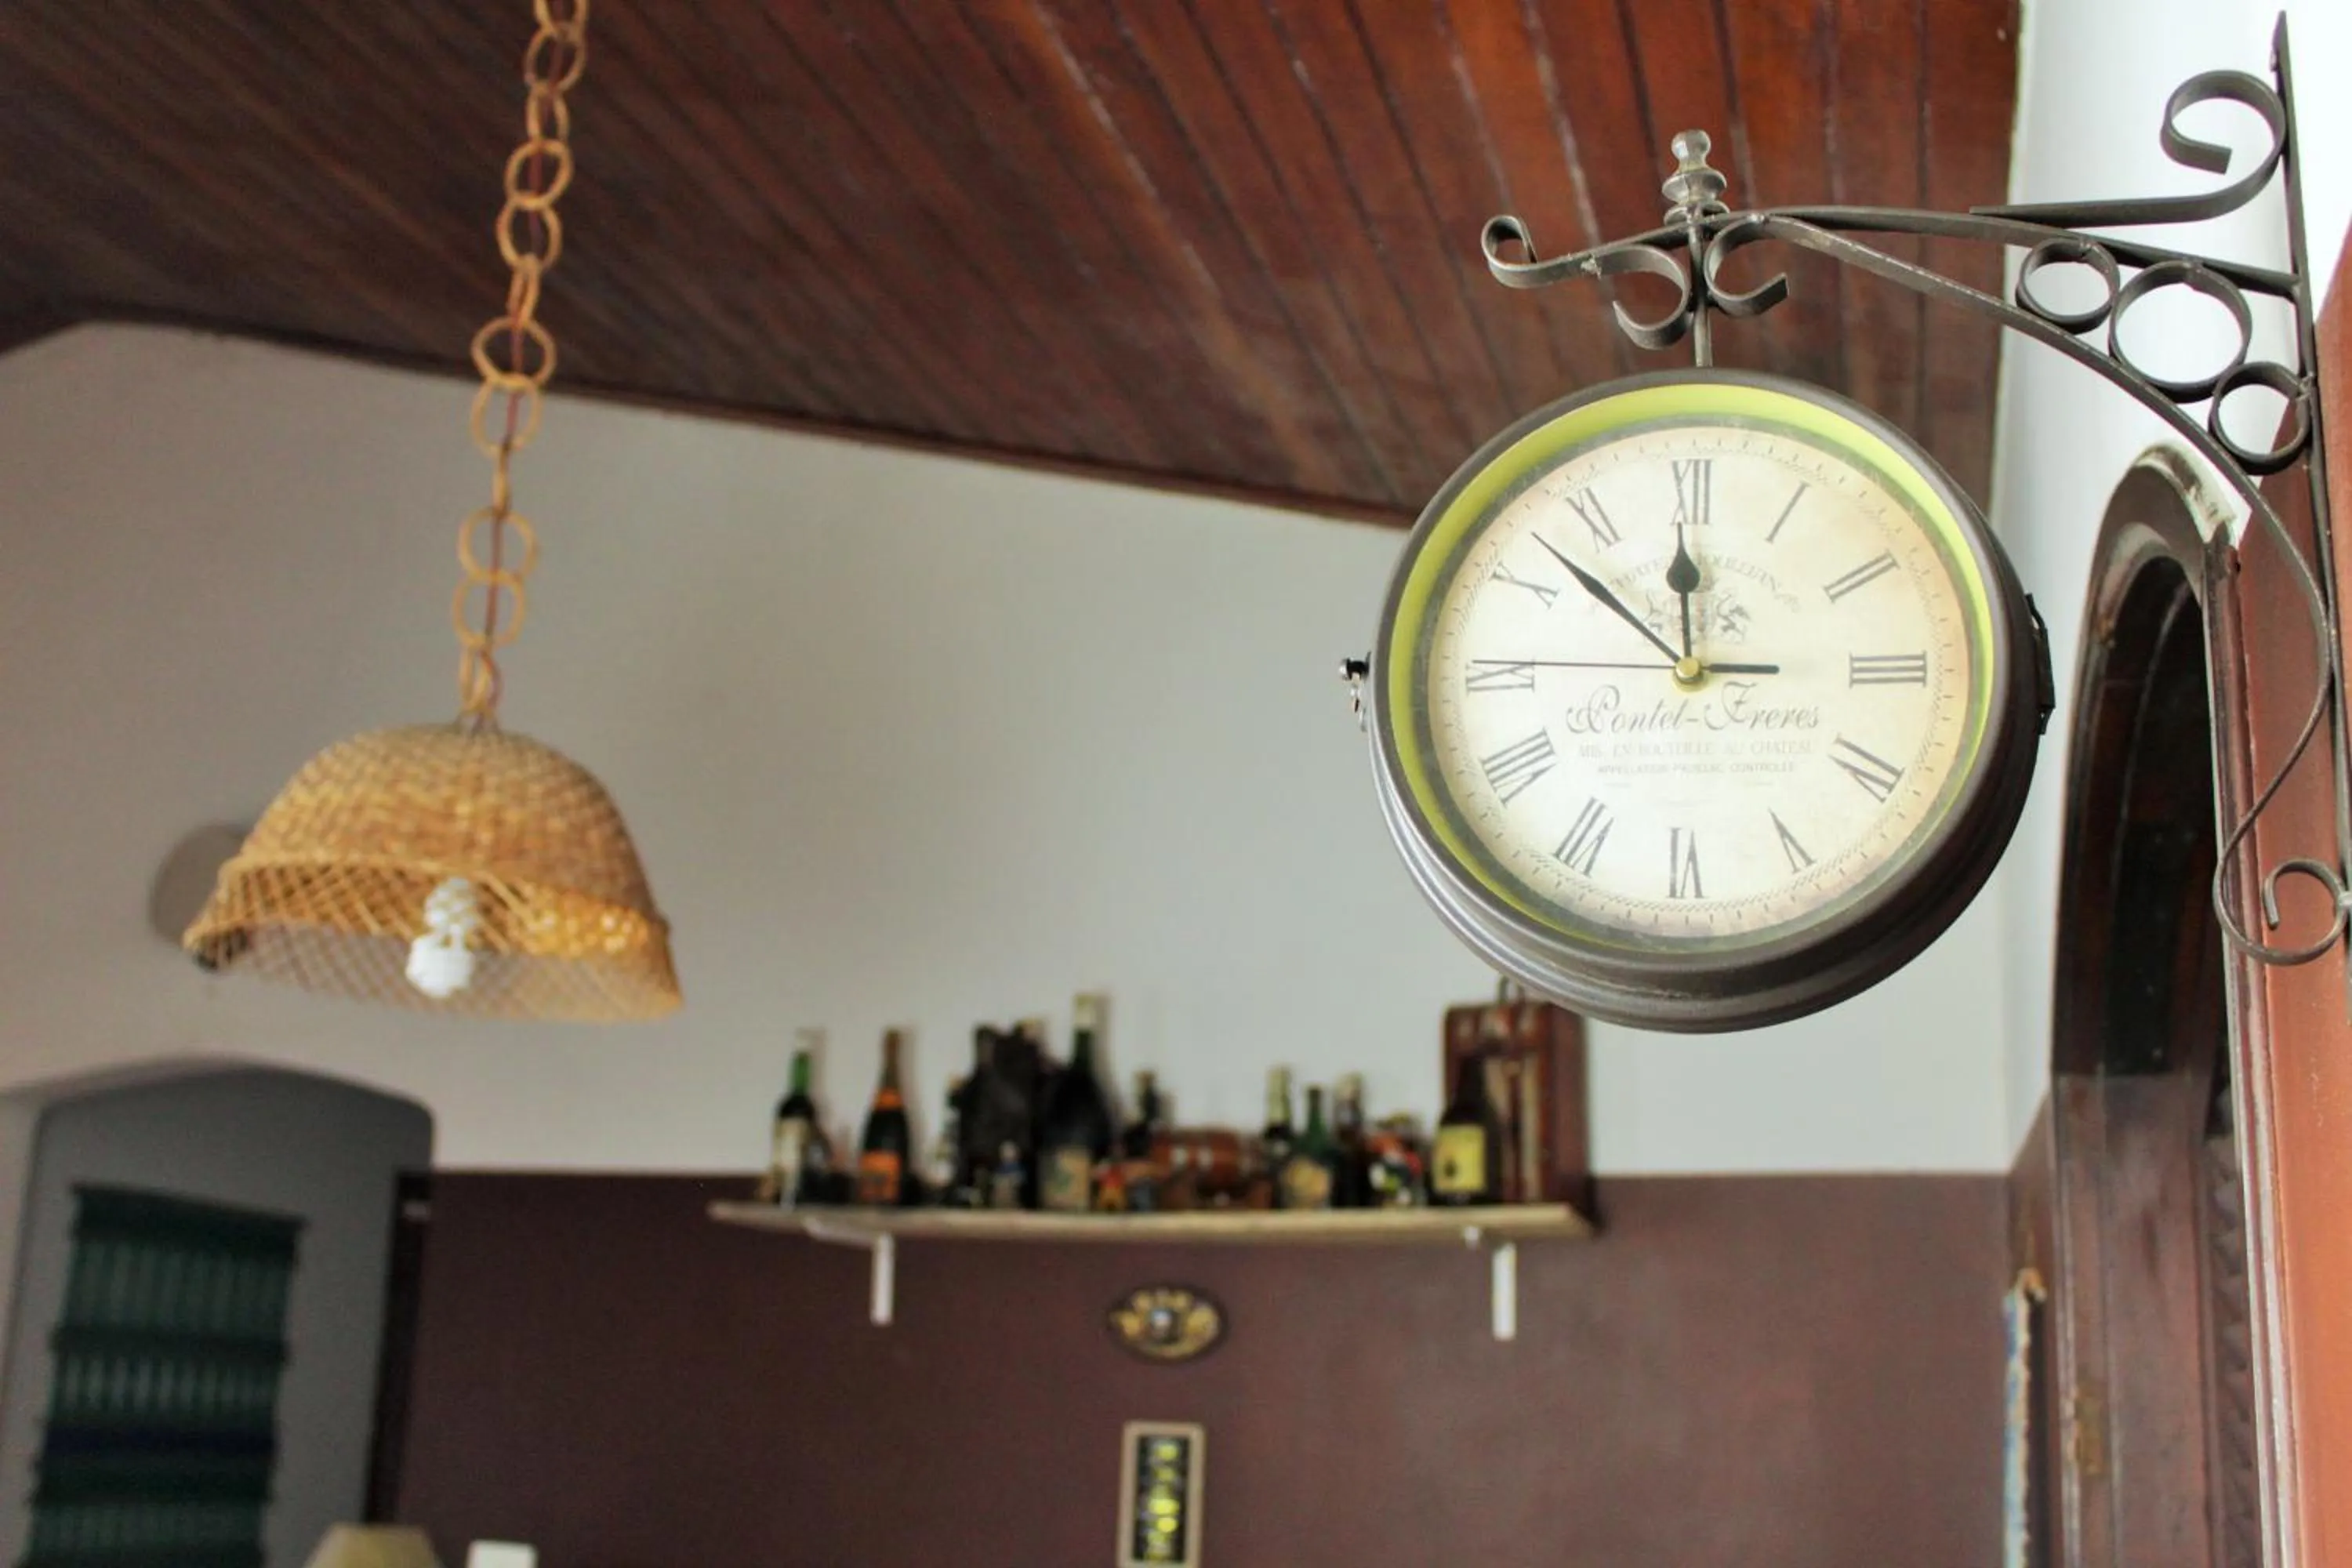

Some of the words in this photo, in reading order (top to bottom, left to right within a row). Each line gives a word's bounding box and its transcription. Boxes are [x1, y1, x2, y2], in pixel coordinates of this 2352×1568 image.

[1670, 458, 1713, 526] XII
[1565, 486, 1623, 554] XI
[1488, 560, 1561, 609] X
[1821, 549, 1901, 603] II
[1465, 657, 1536, 698] IX
[1848, 649, 1928, 689] III
